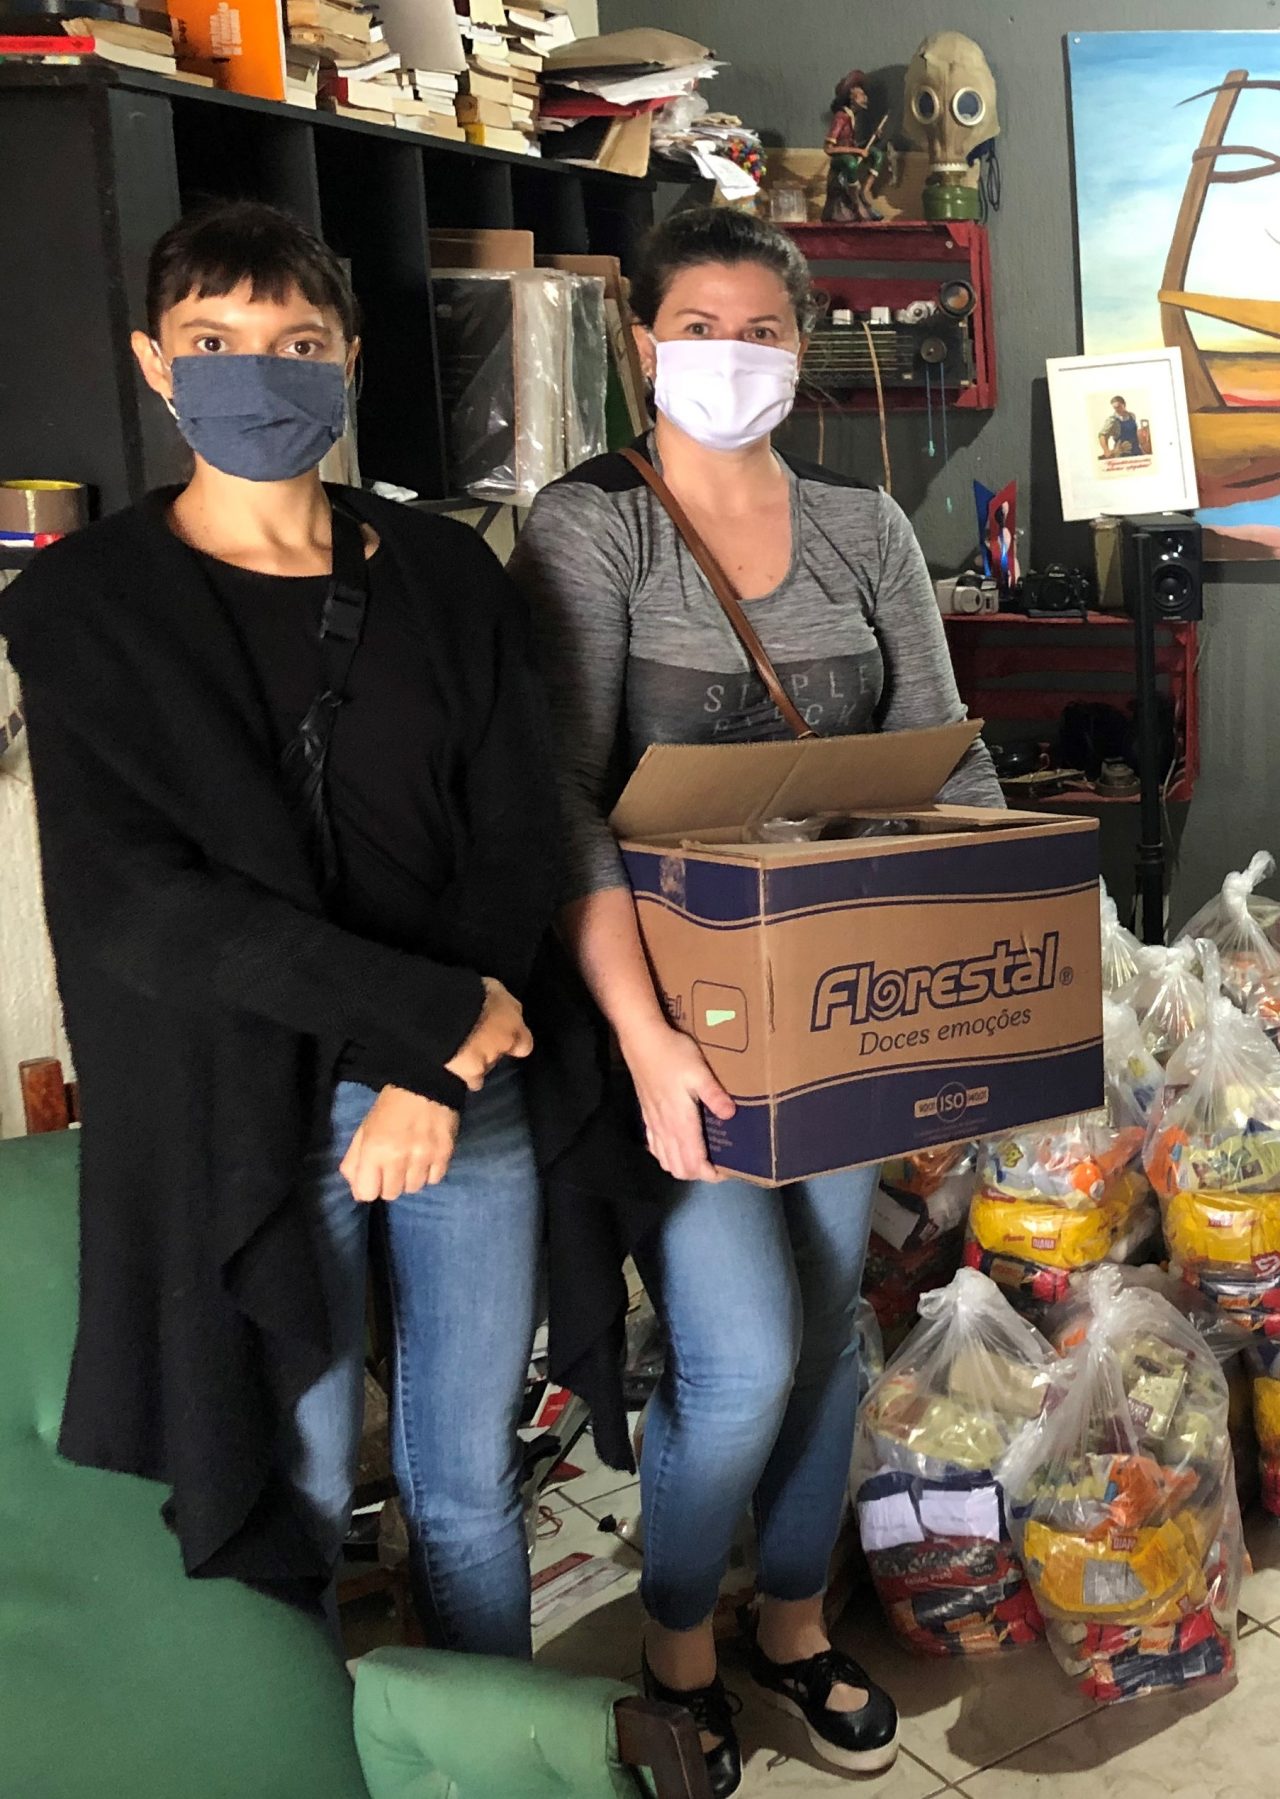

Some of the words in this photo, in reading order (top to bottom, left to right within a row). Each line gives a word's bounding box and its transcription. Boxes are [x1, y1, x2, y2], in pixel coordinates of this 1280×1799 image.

[703, 664, 870, 713] SIPLE
[810, 931, 1059, 1033] Florestal
[859, 1027, 930, 1056] Doces
[937, 1008, 1031, 1041] emoções
[940, 1092, 964, 1112] ISO
